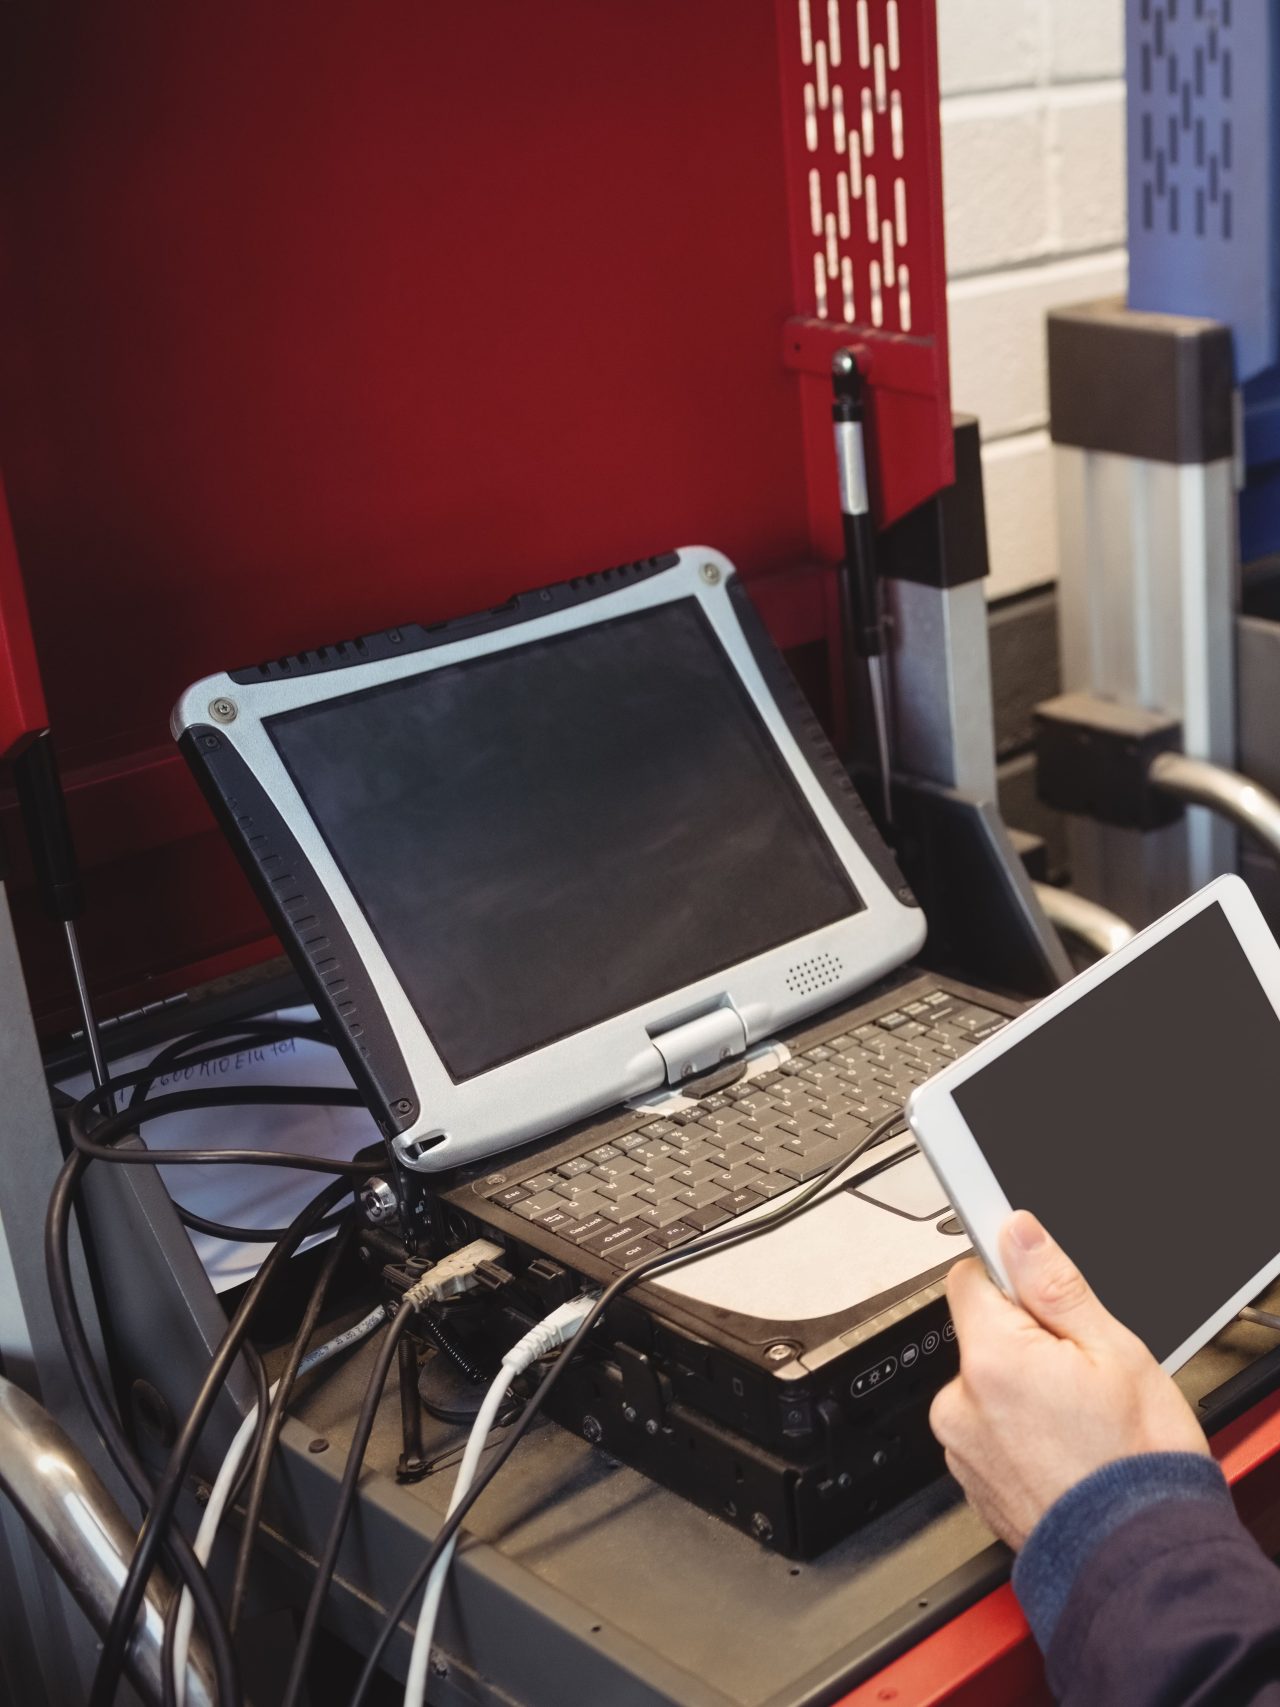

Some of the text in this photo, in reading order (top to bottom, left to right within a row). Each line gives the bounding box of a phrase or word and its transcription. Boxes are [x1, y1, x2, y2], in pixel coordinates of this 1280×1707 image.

[504, 1190, 521, 1199] Esc
[569, 1217, 602, 1235] Caps Lock
[613, 1227, 633, 1238] Shift
[625, 1246, 642, 1256] Ctrl
